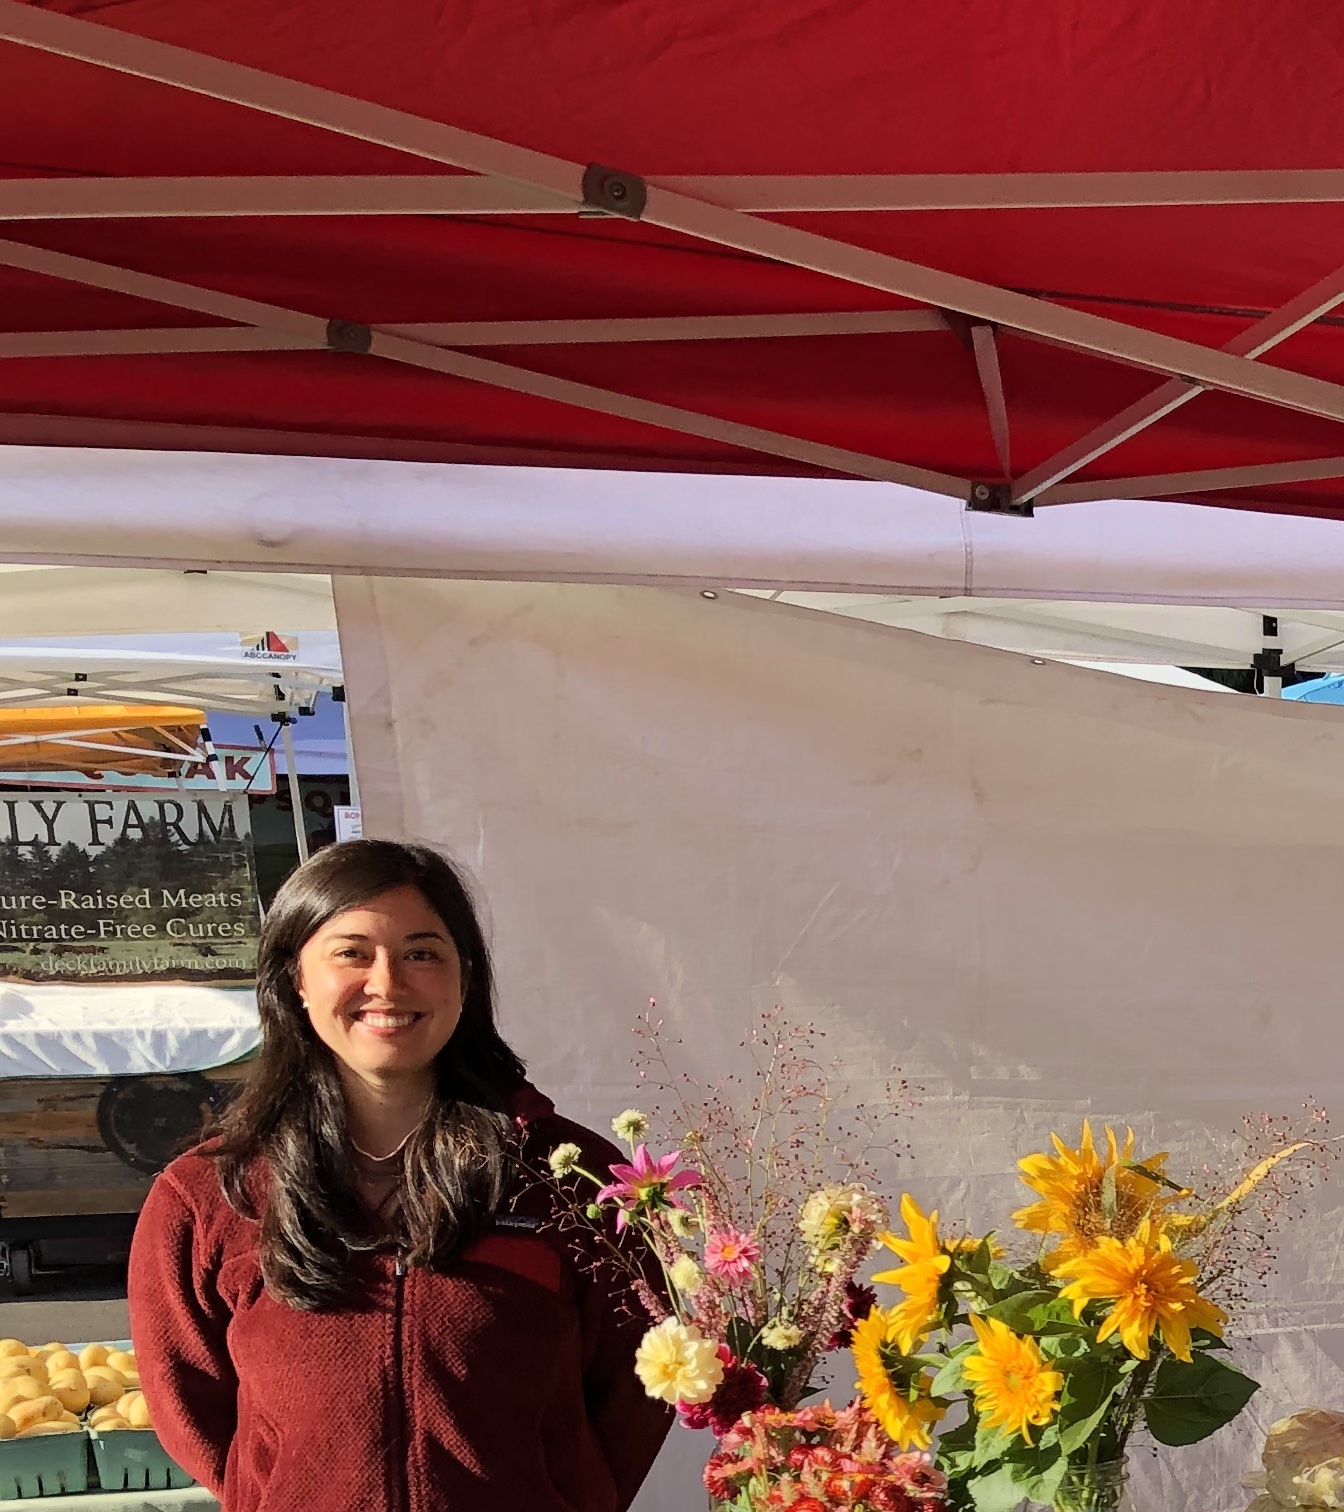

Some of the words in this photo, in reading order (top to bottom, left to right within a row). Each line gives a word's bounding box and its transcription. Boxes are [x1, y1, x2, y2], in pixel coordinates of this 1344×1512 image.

[243, 651, 297, 660] ABCCANOPY
[83, 800, 238, 848] FARM
[161, 888, 242, 908] Meats
[166, 918, 246, 938] Cures
[40, 955, 247, 974] deckfamilyfarm.com
